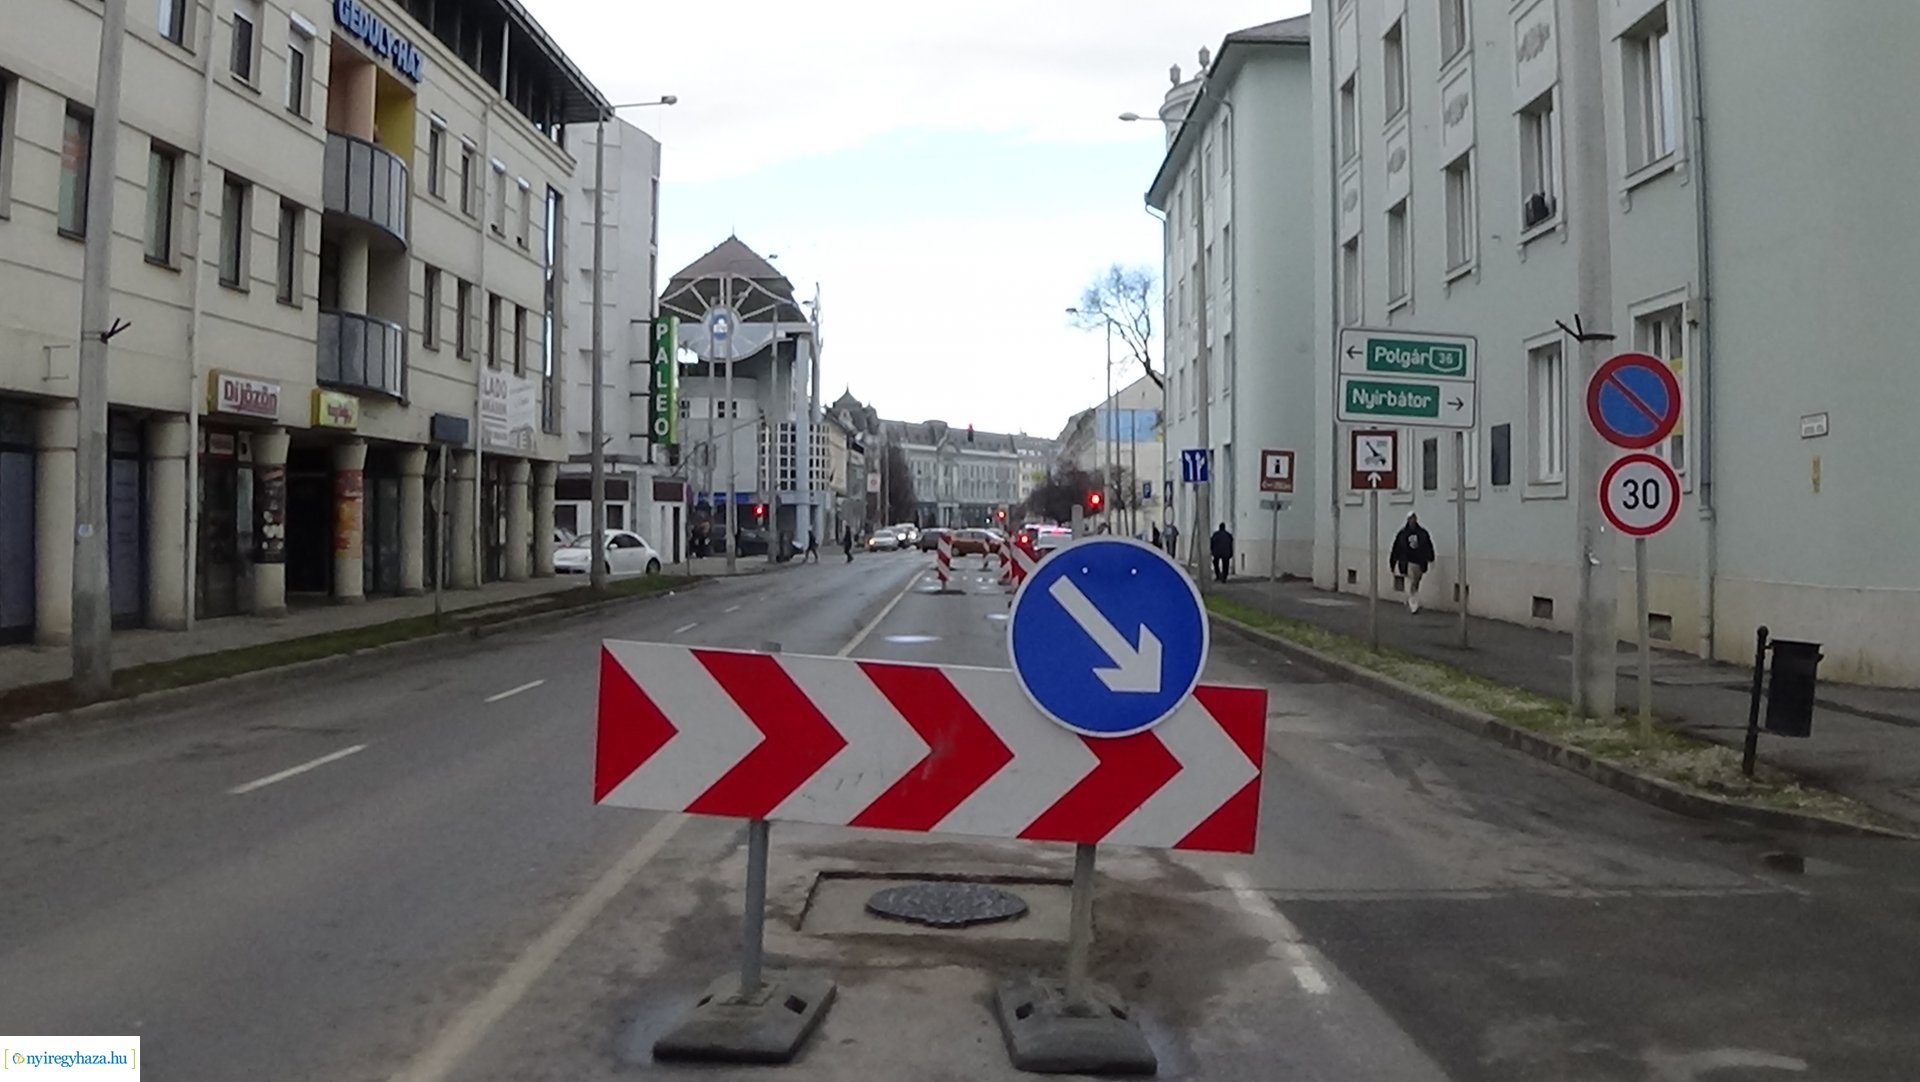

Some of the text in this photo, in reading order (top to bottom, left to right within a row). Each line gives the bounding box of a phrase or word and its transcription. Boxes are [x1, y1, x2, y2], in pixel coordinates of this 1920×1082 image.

[1374, 345, 1429, 368] Polgár
[1438, 352, 1454, 365] 36
[654, 323, 669, 436] PALEO
[1623, 478, 1660, 510] 30
